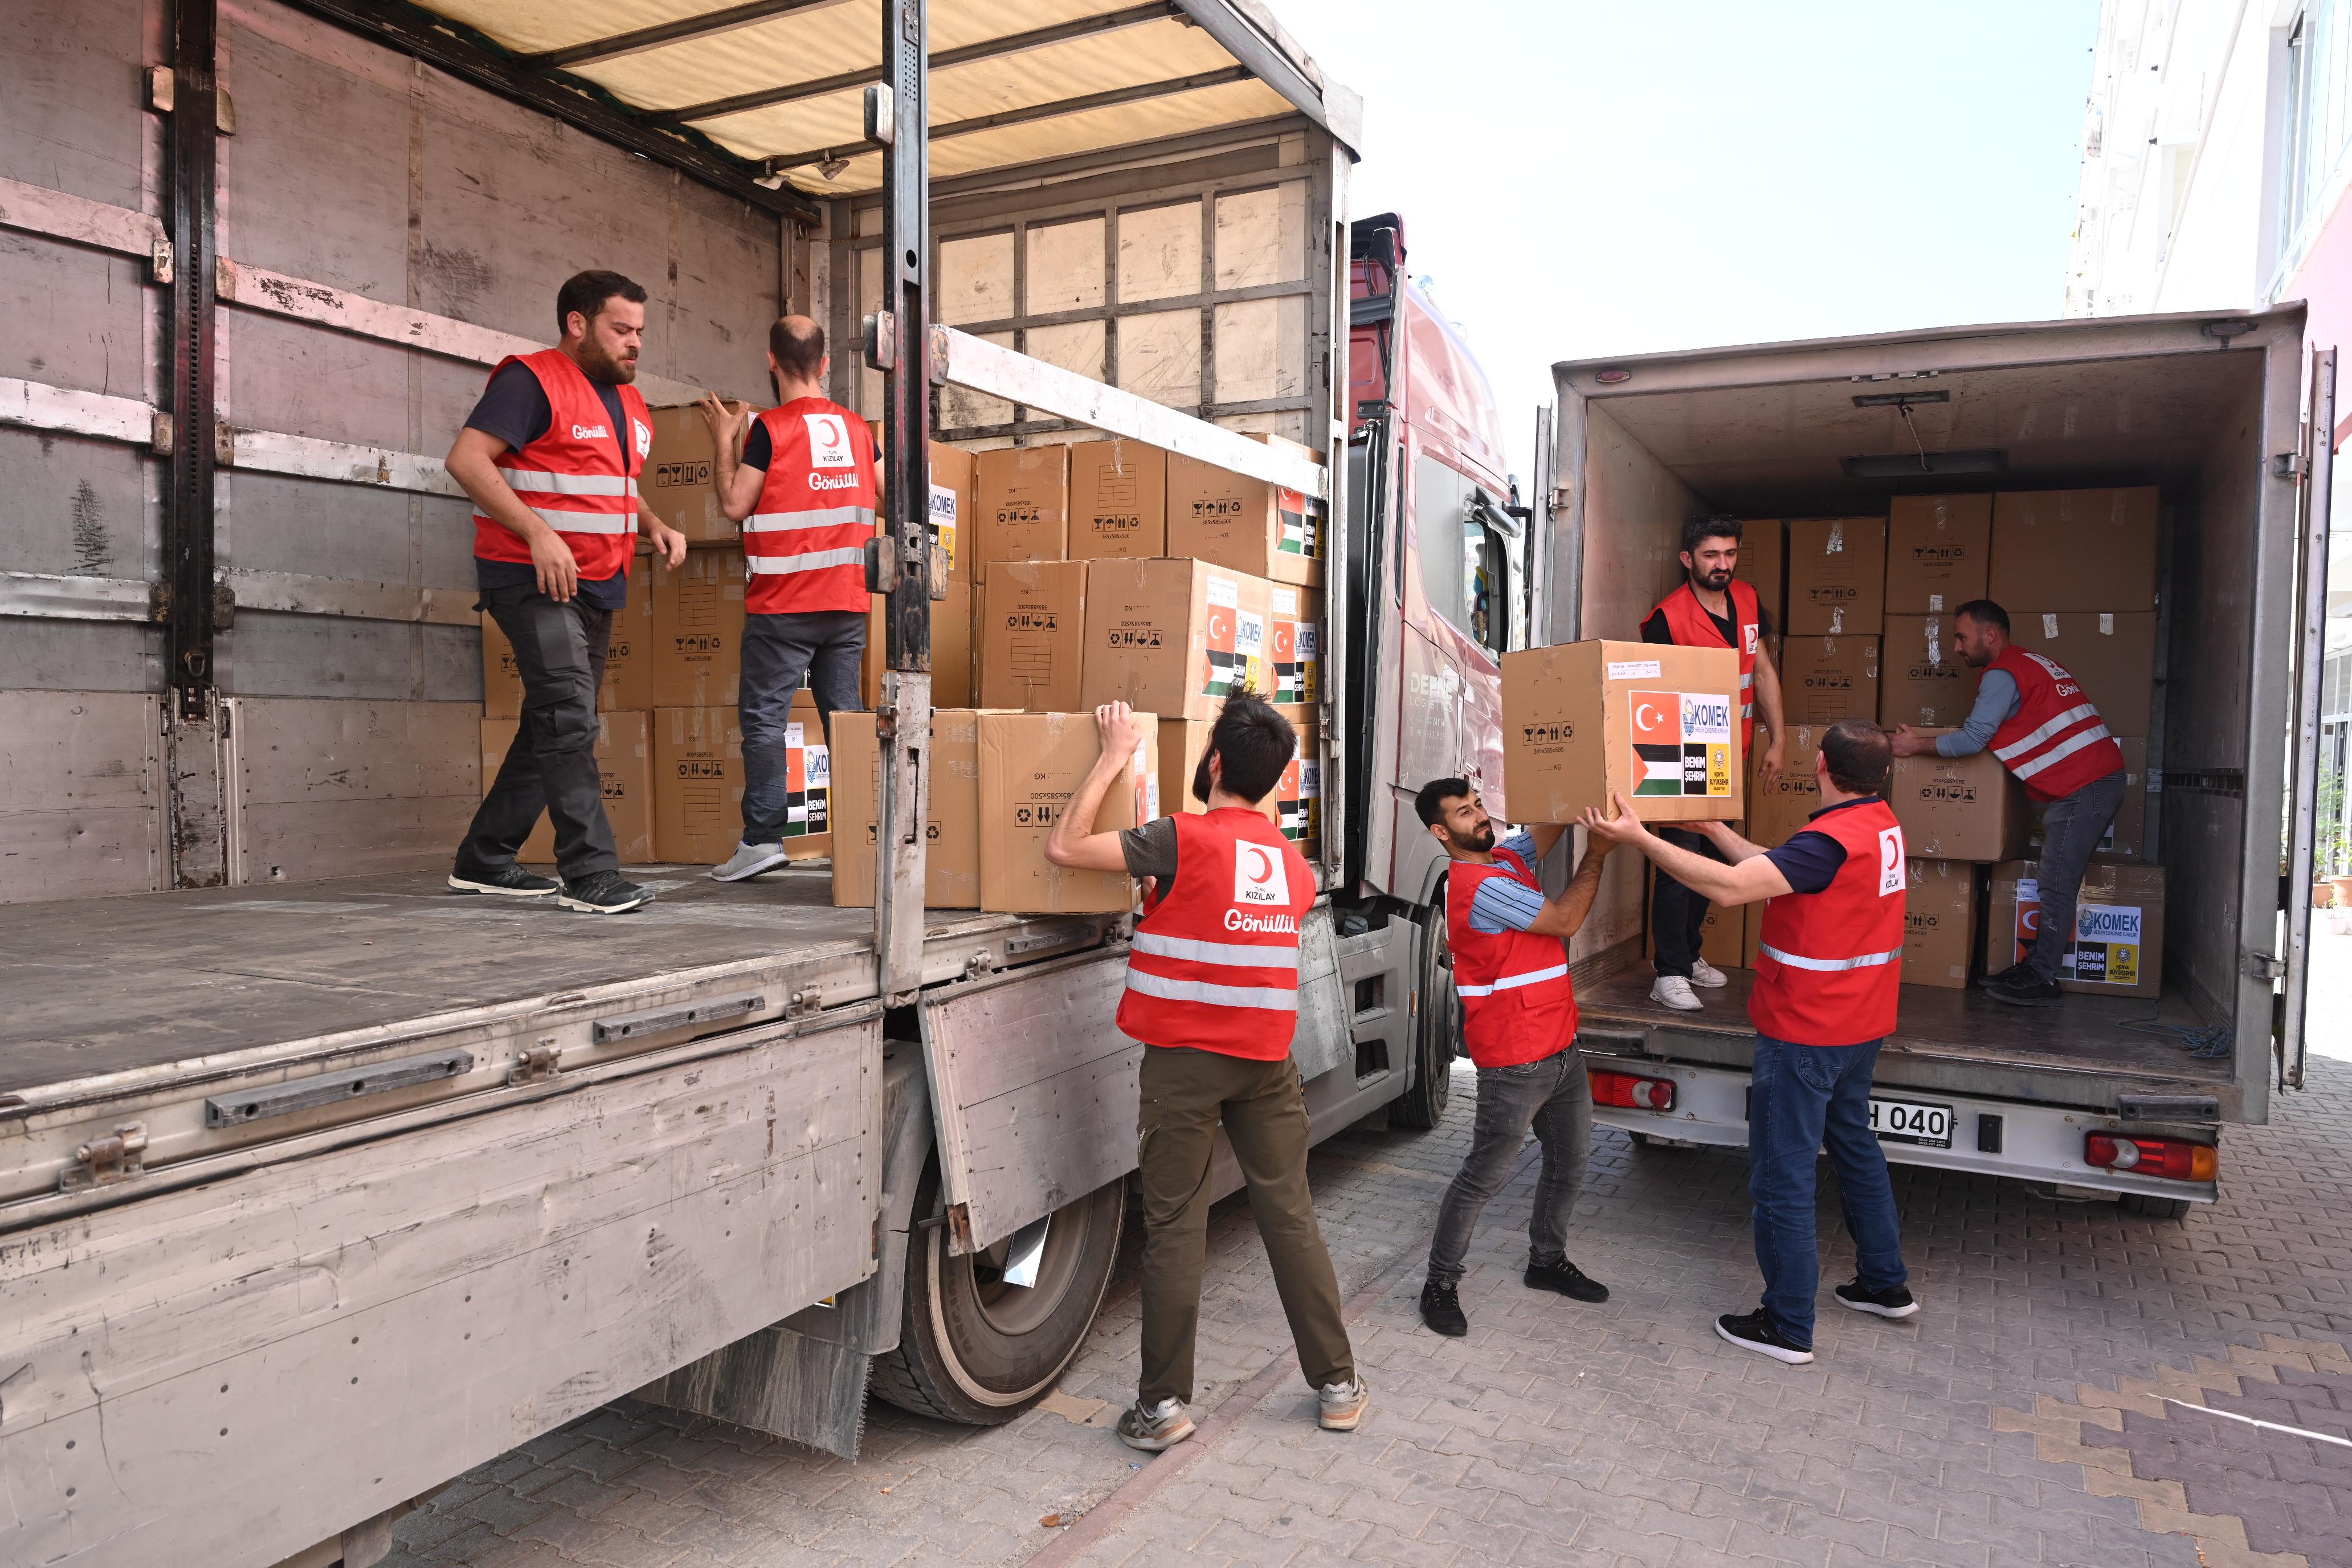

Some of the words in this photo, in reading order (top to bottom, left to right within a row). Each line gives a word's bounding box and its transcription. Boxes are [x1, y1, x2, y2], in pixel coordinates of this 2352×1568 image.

[572, 424, 609, 439] Gönüllü
[932, 493, 956, 516] KOMEK
[929, 533, 938, 545] ENİM
[1242, 620, 1262, 643] KOMEK
[1300, 630, 1316, 648] KOMEK
[1694, 704, 1729, 727] KOMEK
[1684, 756, 1705, 769] BENİM
[1685, 770, 1706, 783] ŞEHRİM
[808, 799, 826, 811] BENİM
[808, 811, 826, 823] ŞEHRİM
[1246, 891, 1276, 901] KIZILAY
[1224, 908, 1298, 934] Gönüllü
[2093, 913, 2139, 932] KOMEK
[2078, 951, 2105, 962] BENİM
[2077, 962, 2104, 971] ŞEHRİM
[1890, 1106, 1945, 1135] 040
